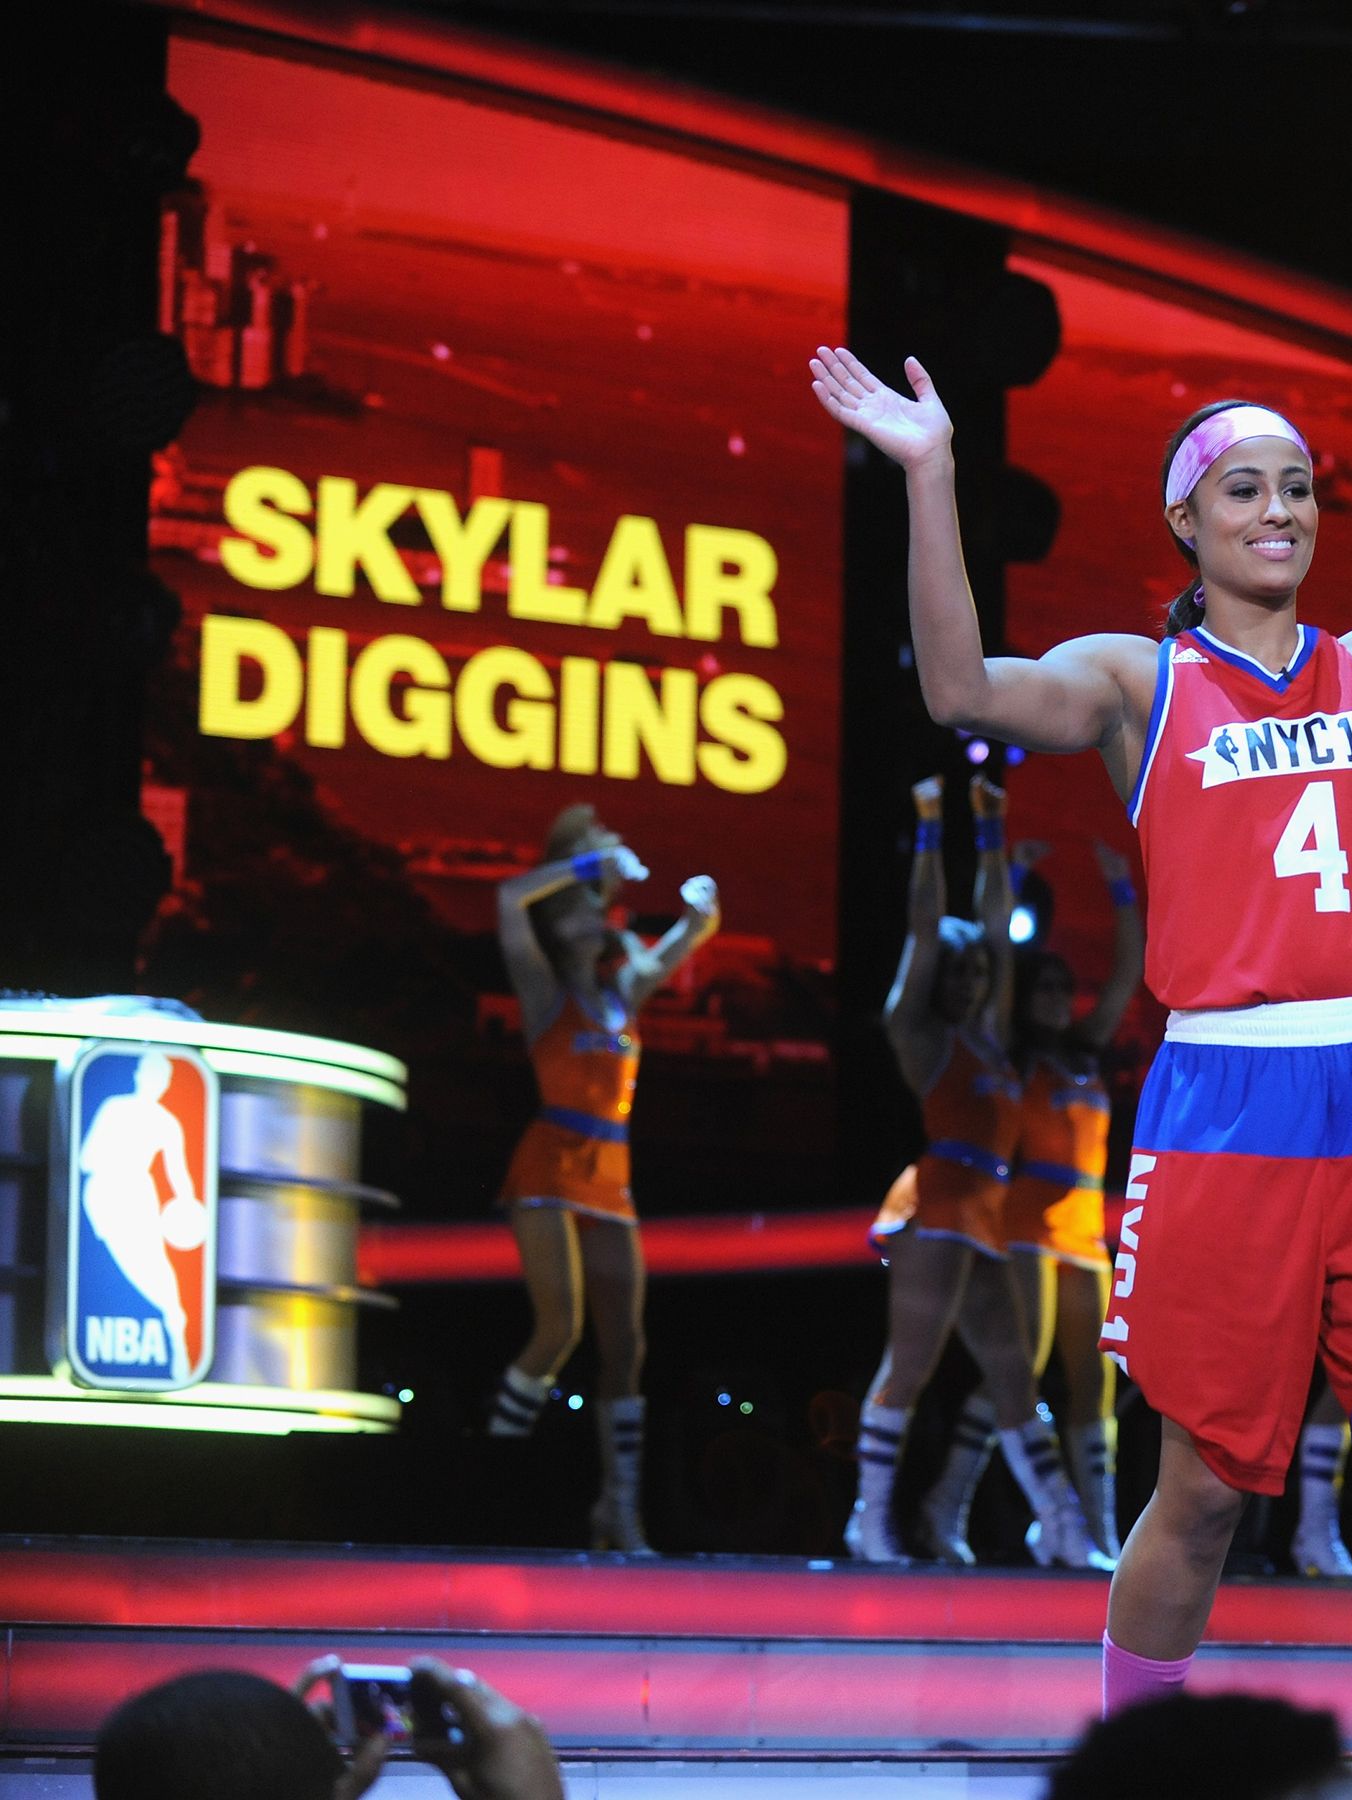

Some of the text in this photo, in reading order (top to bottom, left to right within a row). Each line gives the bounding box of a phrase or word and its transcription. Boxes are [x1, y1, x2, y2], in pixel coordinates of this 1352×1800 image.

[219, 466, 778, 648] SKYLAR
[199, 613, 787, 794] DIGGINS
[1245, 717, 1334, 772] NYC
[1273, 780, 1351, 912] 4
[85, 1315, 168, 1366] NBA
